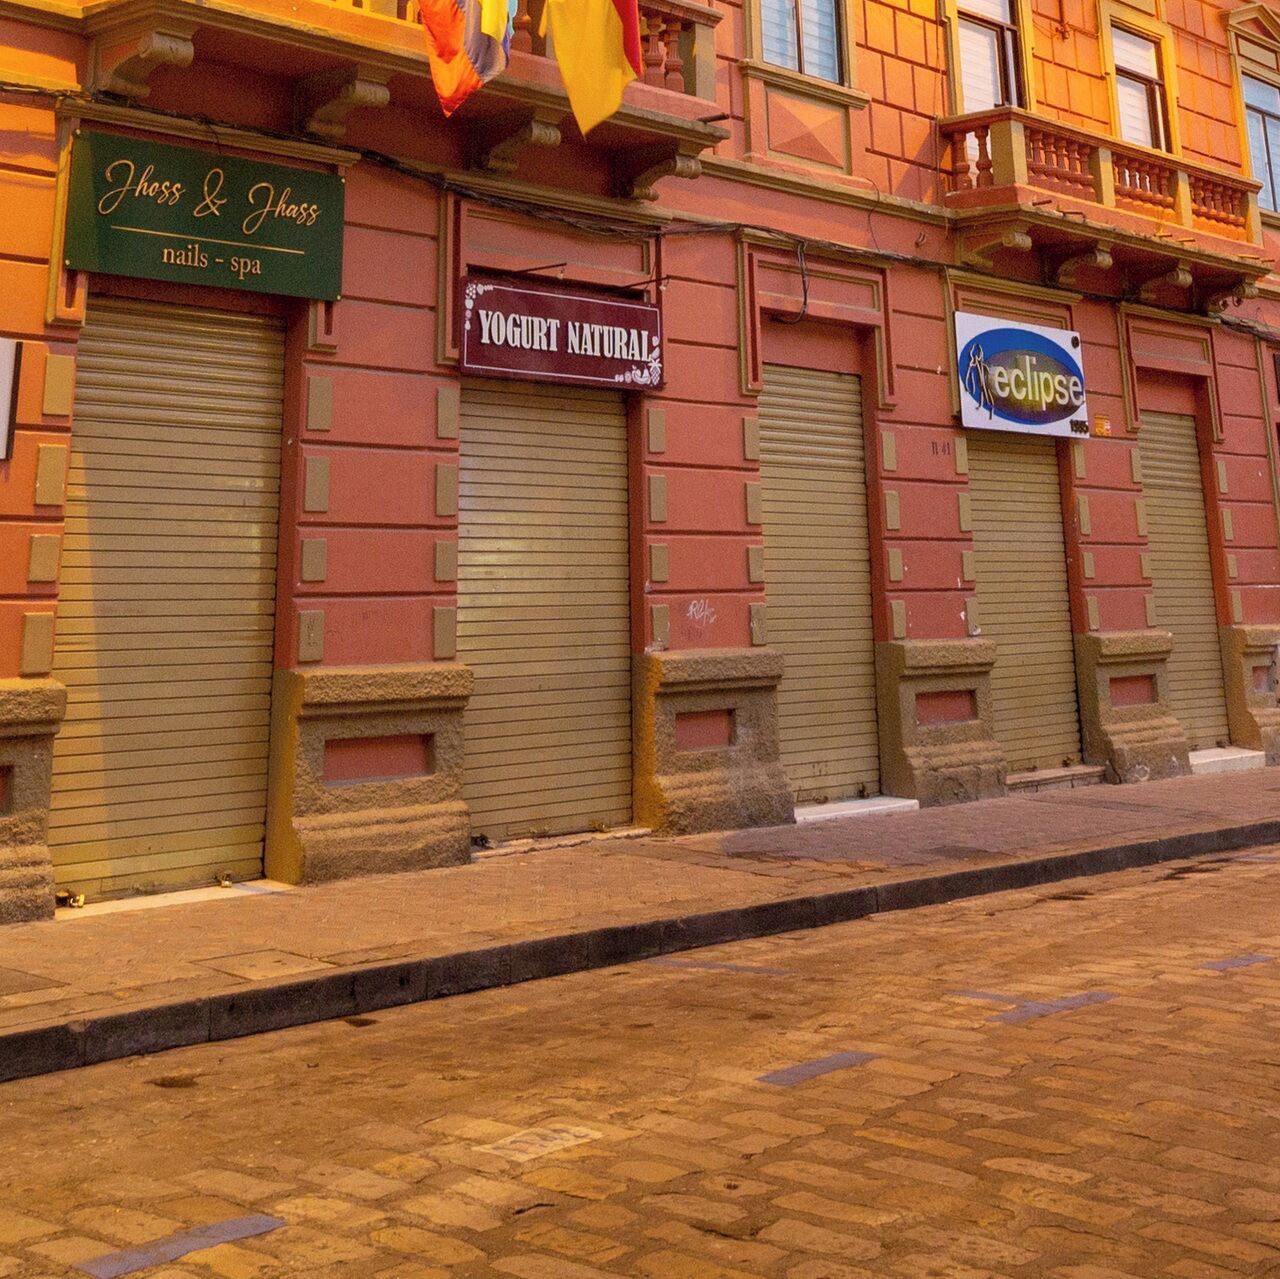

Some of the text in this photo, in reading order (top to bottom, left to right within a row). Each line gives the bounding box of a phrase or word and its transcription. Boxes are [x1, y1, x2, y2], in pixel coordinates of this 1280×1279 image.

[98, 159, 321, 236] Jhoss & Jhass
[161, 244, 209, 268] nails
[230, 255, 262, 280] spa
[478, 309, 652, 363] YOGURT NATURAL
[993, 355, 1084, 411] eclipse
